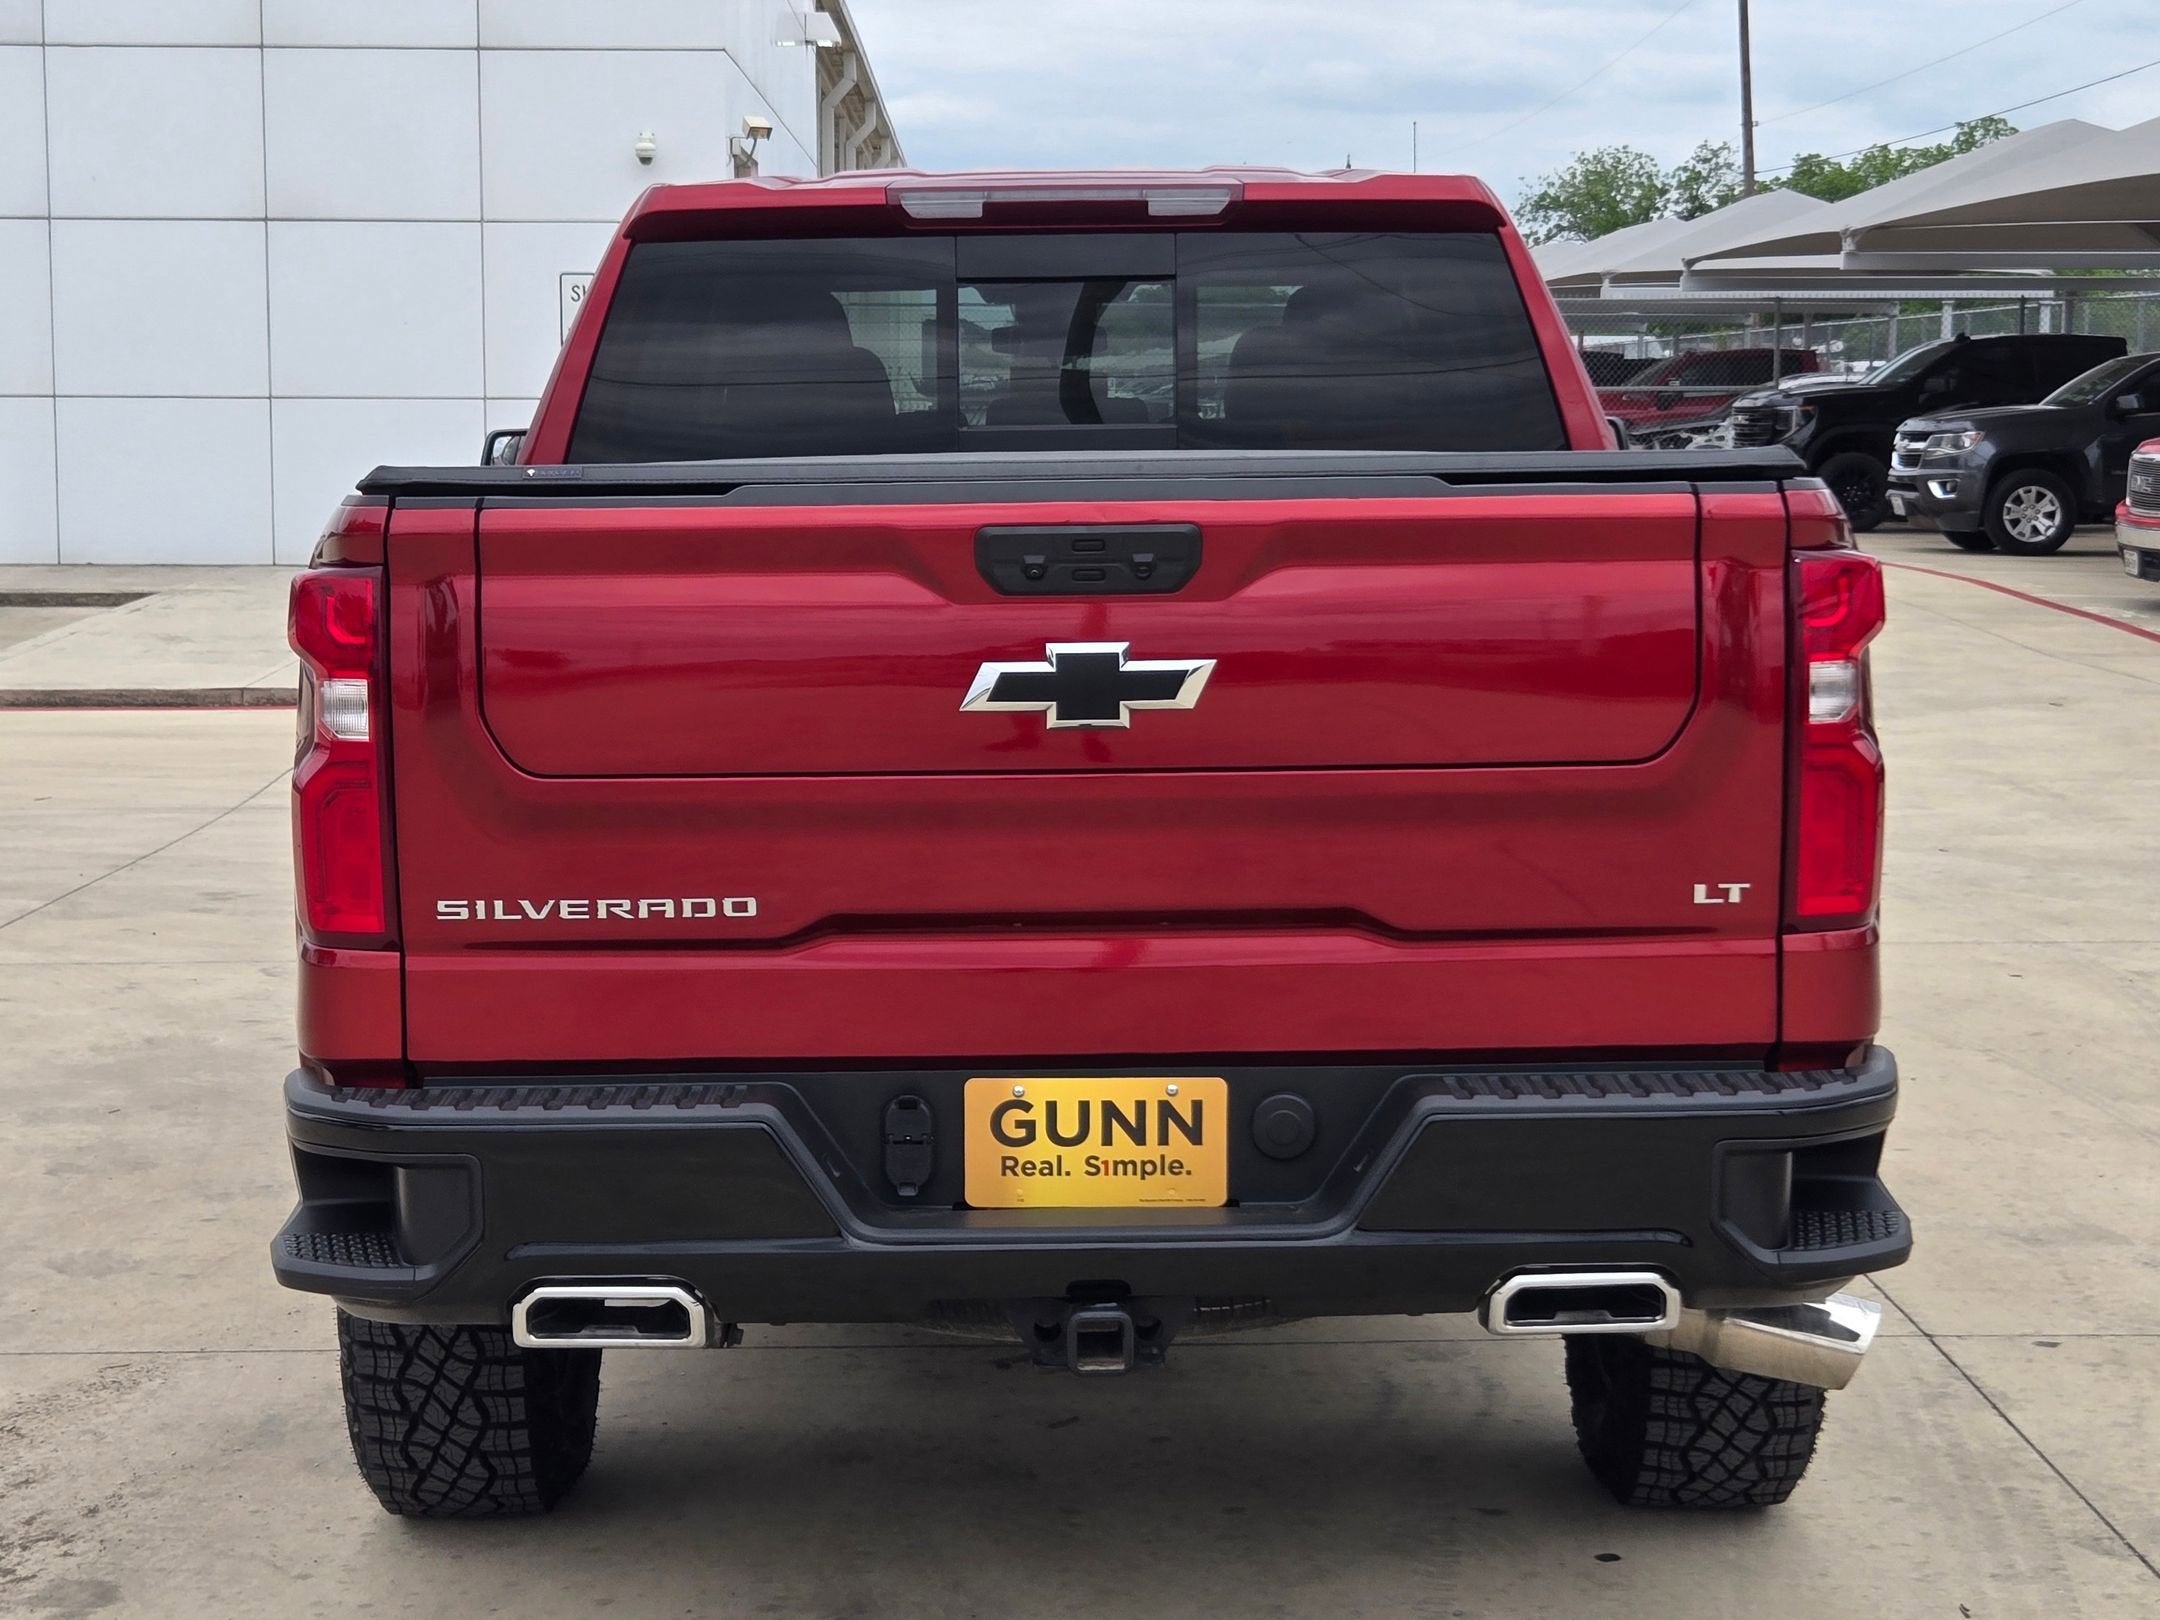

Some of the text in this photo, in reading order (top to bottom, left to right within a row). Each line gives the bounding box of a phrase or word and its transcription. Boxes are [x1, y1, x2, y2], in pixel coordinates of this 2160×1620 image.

[1693, 883, 1751, 904] LT
[436, 896, 759, 920] SILVERADO
[990, 1099, 1203, 1147] GUNN
[1000, 1155, 1071, 1177] Real.
